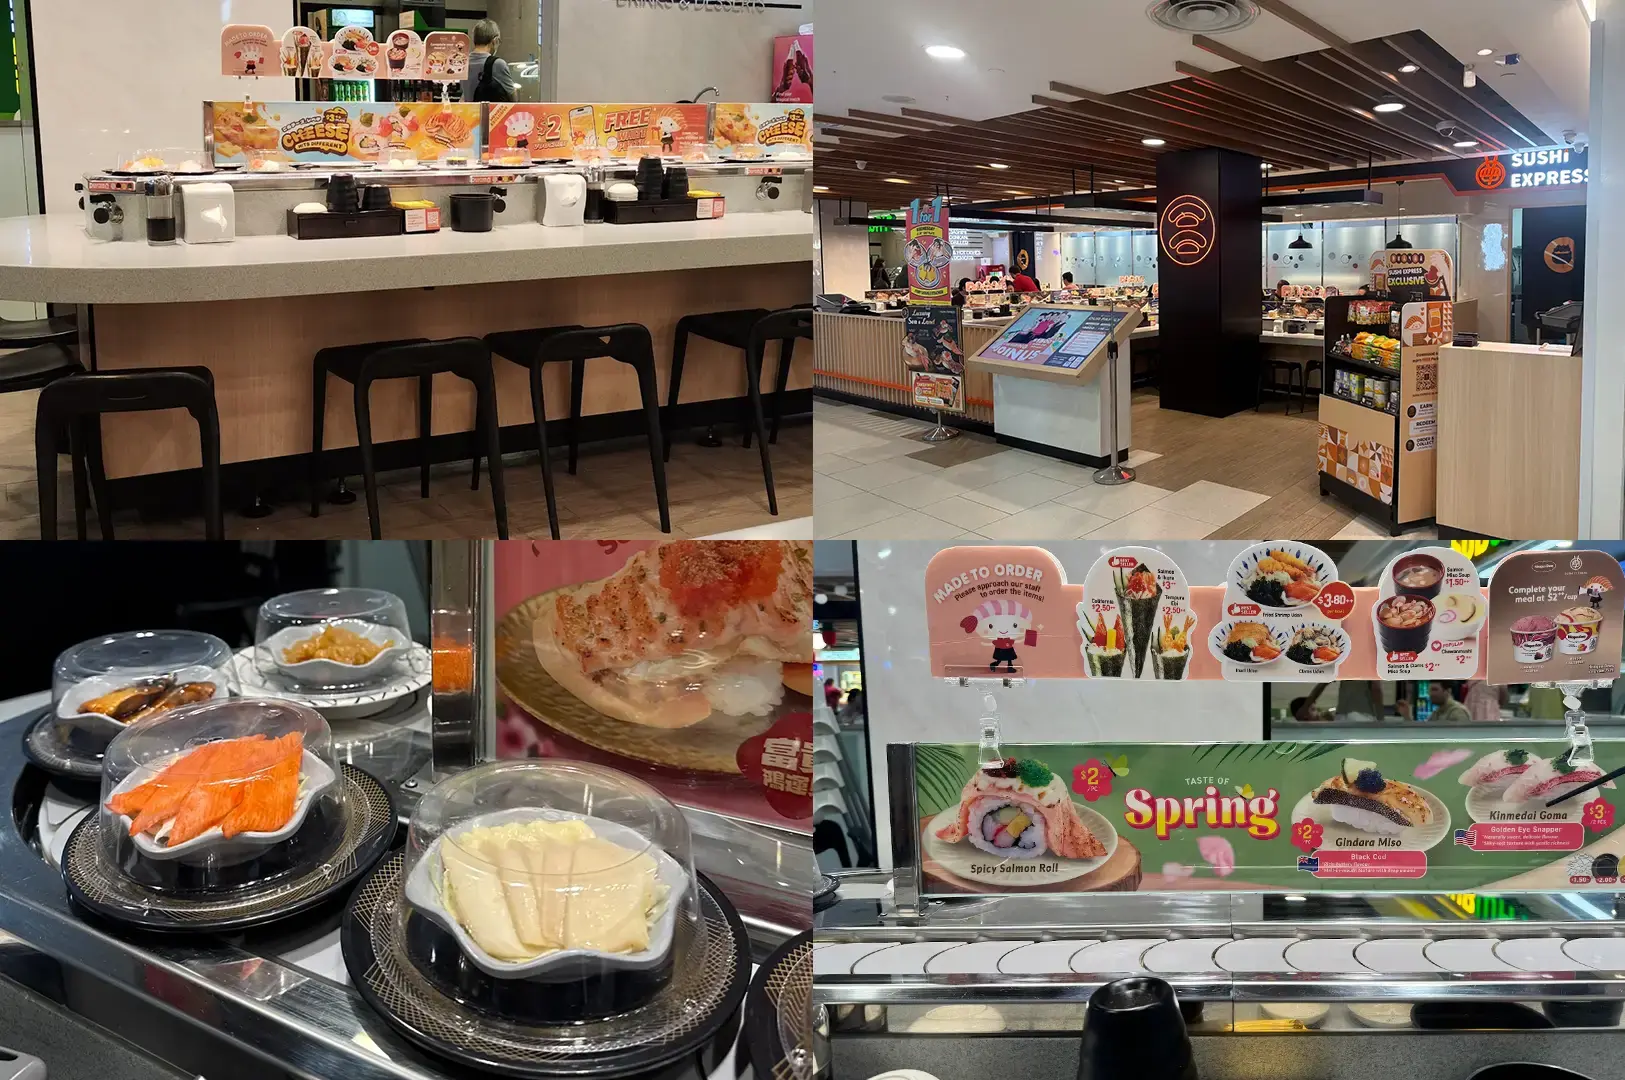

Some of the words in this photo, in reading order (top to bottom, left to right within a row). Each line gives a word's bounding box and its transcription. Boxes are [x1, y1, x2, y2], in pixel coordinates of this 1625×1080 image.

[536, 114, 562, 141] $2
[604, 108, 652, 133] FREE
[282, 122, 350, 148] CHEESE
[758, 121, 805, 142] CHEESE
[910, 198, 920, 224] 1
[920, 211, 932, 222] for
[932, 196, 943, 223] 1
[1388, 276, 1425, 286] EXCLUSIVE
[992, 346, 1020, 361] JOIN
[933, 572, 970, 604] MADE
[970, 566, 990, 581] TO
[994, 564, 1043, 582] ORDER
[954, 586, 976, 601] Please
[977, 580, 1008, 590] approach
[1024, 583, 1041, 592] staff
[1446, 579, 1469, 588] $1.50++
[1508, 586, 1546, 595] Complete
[1548, 585, 1566, 594] your
[980, 590, 988, 598] to
[1010, 587, 1021, 595] the
[1023, 590, 1044, 602] items!
[1318, 594, 1354, 608] $3.80++
[1092, 604, 1116, 612] $2.50++
[1185, 776, 1214, 786] TASTE
[1218, 777, 1230, 786] OF
[1124, 786, 1280, 840] Spring
[1489, 811, 1536, 820] Kinmedai
[1540, 811, 1568, 820] Goma
[1335, 838, 1376, 847] Gindara
[1378, 838, 1402, 847] Miso
[970, 864, 997, 874] Spicy
[1000, 863, 1036, 873] Salmon
[1039, 863, 1058, 872] Roll
